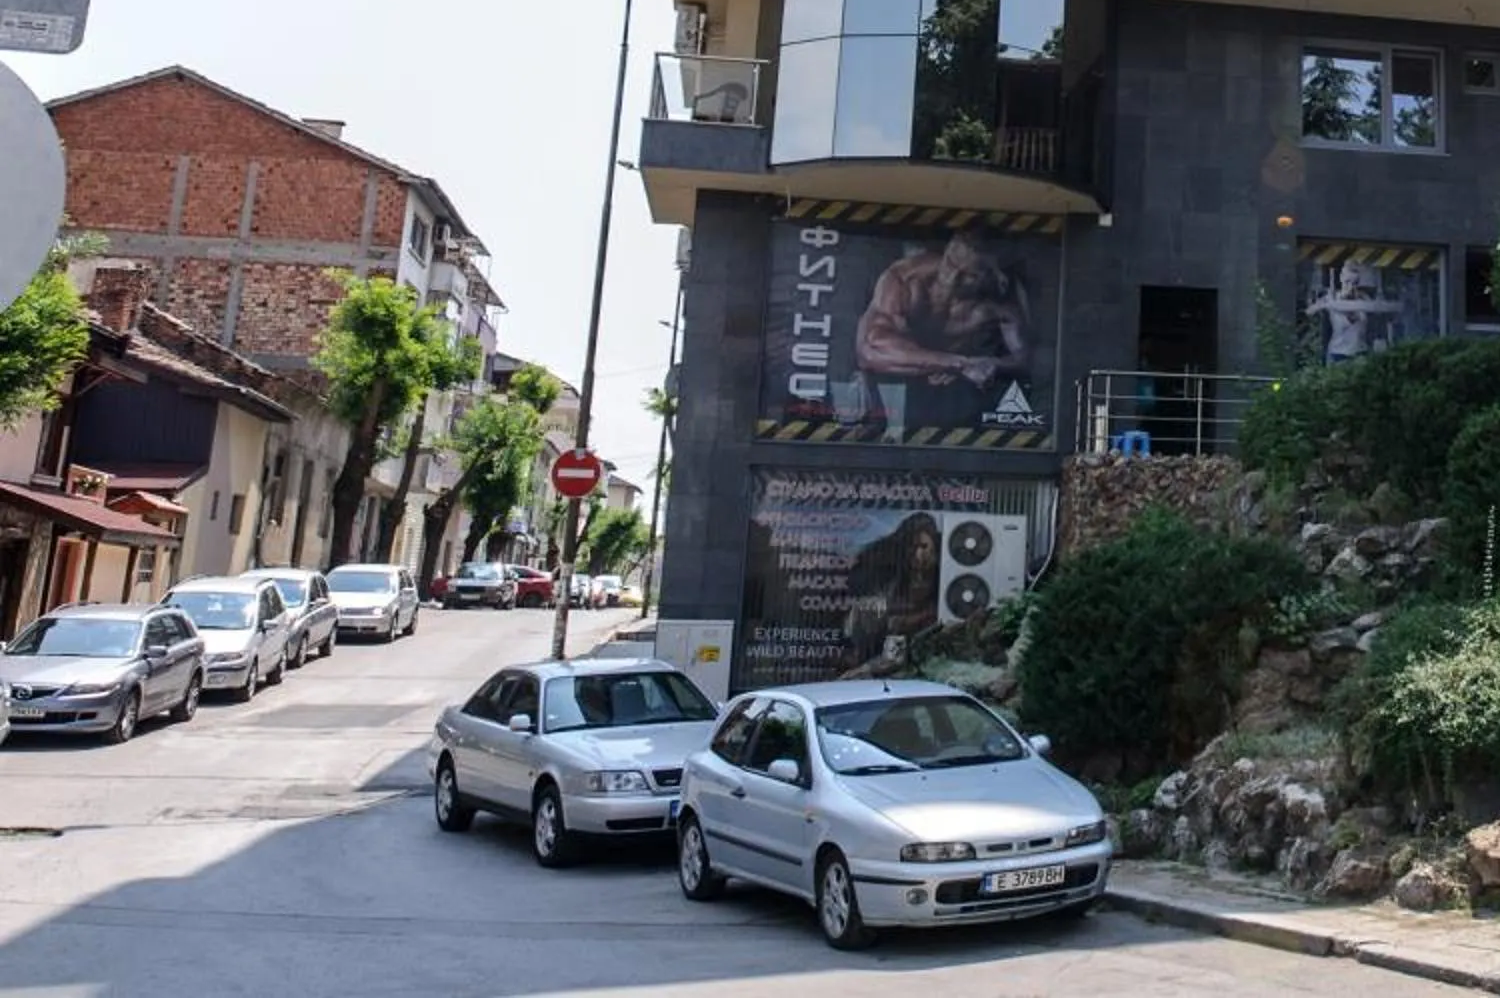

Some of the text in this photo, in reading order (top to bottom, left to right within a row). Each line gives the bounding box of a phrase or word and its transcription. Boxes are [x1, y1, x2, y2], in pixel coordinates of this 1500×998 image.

[788, 225, 840, 399] ФИТНЕС
[981, 413, 1045, 425] PEAK
[754, 627, 841, 642] EXPERIENCE
[746, 645, 845, 659] WILD BEAUTY
